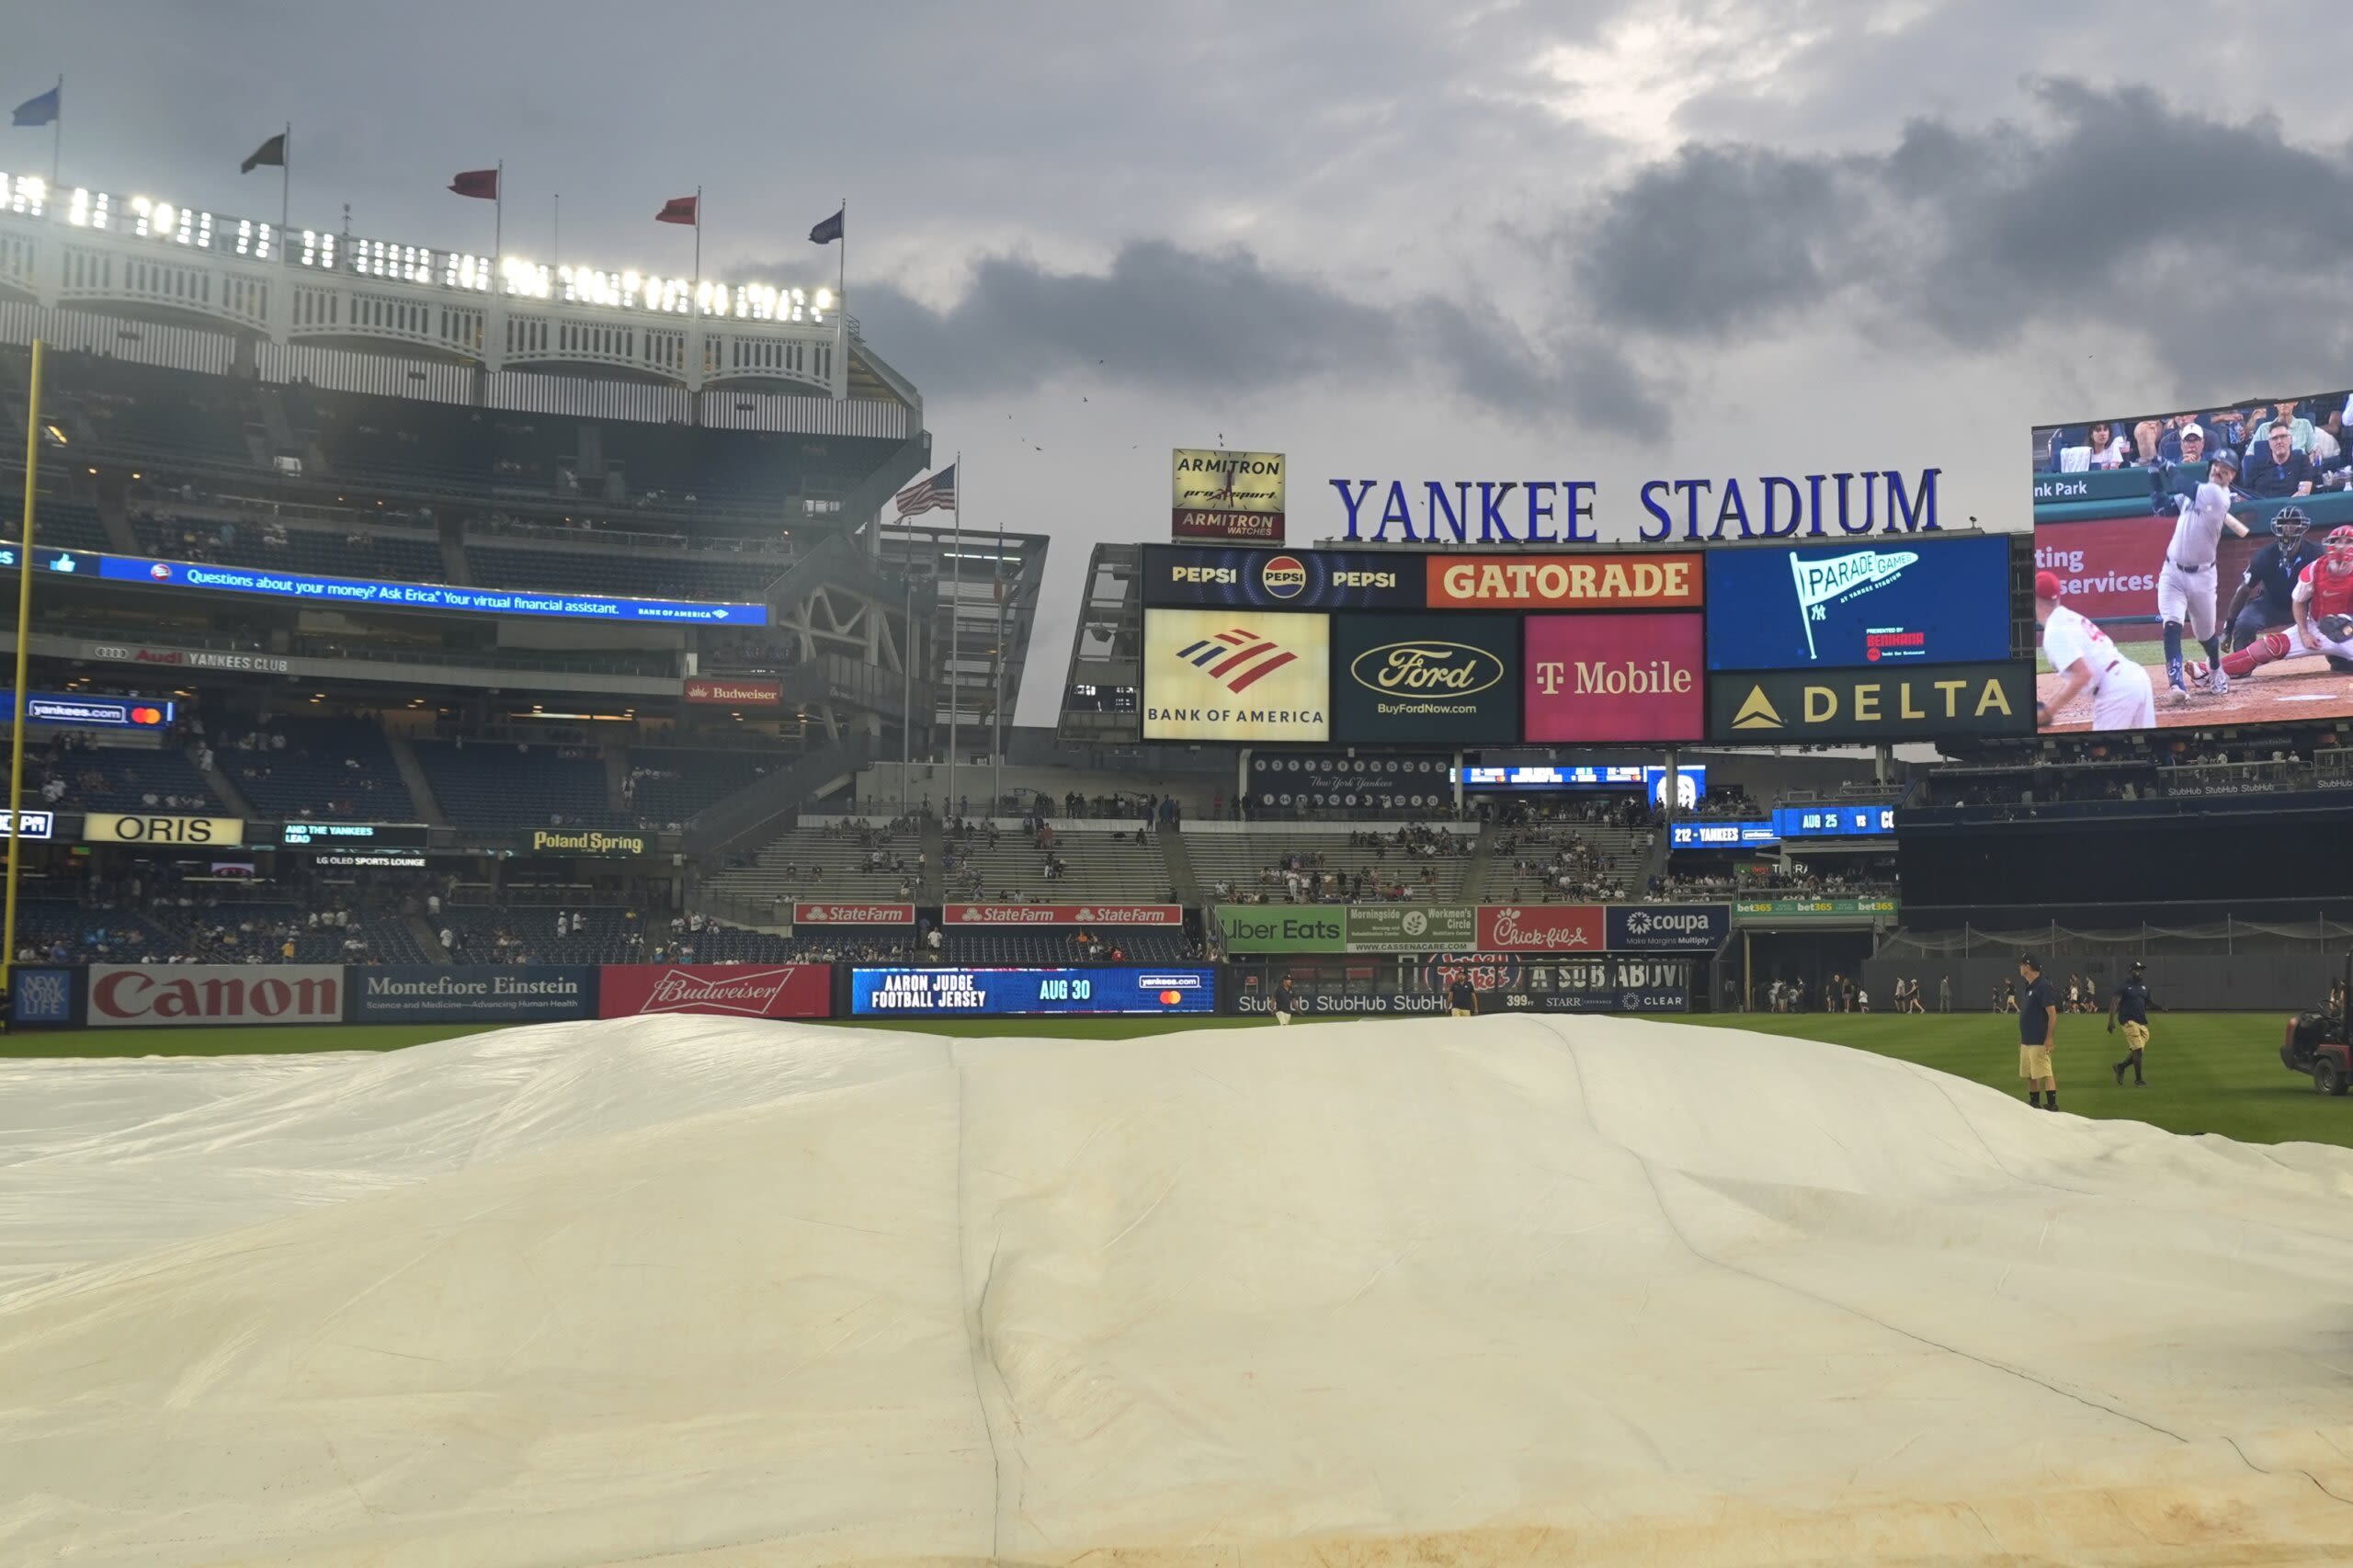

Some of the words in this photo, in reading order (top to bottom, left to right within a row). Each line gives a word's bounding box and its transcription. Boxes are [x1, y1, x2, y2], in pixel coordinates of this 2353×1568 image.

[1177, 459, 1279, 475] ARMITRON
[2055, 481, 2087, 496] Park
[1328, 479, 1597, 543] YANKEE
[1638, 468, 1943, 542] STADIUM
[1182, 513, 1274, 528] ARMITRON
[1227, 527, 1272, 535] WATCHES
[1172, 566, 1237, 585] PEPSI
[1265, 571, 1303, 583] PEPSI
[1332, 572, 1396, 588] PEPSI
[1444, 562, 1689, 599] GATORADE
[1809, 555, 1873, 597] PARADE
[1878, 554, 1913, 574] GAMES
[188, 569, 254, 587] Questions
[256, 576, 293, 592] about
[295, 582, 324, 595] your
[327, 584, 378, 599] money?
[380, 586, 403, 600] Ask
[444, 591, 472, 606] Your
[473, 595, 511, 608] virtual
[514, 597, 563, 611] financial
[564, 601, 620, 616] assistant.
[638, 608, 662, 617] BANK
[662, 608, 674, 618] OF
[674, 609, 711, 619] AMERICA
[135, 649, 183, 664] Audi
[189, 653, 250, 670] YANKEES
[254, 658, 288, 672] CLUB
[1378, 648, 1476, 689] Ford
[1536, 662, 1564, 695] T
[1574, 660, 1692, 695] Mobile
[713, 687, 778, 699] Budweiser
[1803, 678, 2013, 723] DELTA
[33, 702, 122, 720] yankees.com
[1148, 709, 1201, 722] BANK
[1206, 709, 1232, 722] OF
[1236, 710, 1324, 724] AMERICA
[1378, 703, 1477, 715] BuyFordNow.com
[1331, 776, 1355, 791] York
[1355, 777, 1393, 791] Yankees
[2204, 787, 2238, 795] StubHub
[2241, 783, 2275, 792] StubHub
[2316, 779, 2353, 790] StubHub
[2167, 788, 2202, 797] StubHub
[1802, 814, 1822, 829] AUG
[1824, 813, 1838, 828] 25
[115, 816, 212, 843] ORIS
[285, 824, 308, 835] AND
[308, 825, 328, 835] THE
[329, 826, 374, 836] YANKEES
[1675, 828, 1692, 843] 212
[1699, 827, 1739, 842] YANKEES
[285, 834, 311, 844] LEAD
[533, 831, 588, 850] Poland
[589, 832, 643, 855] Spring
[316, 856, 329, 865] LG
[329, 857, 354, 865] OLED
[355, 857, 391, 866] SPORTS
[390, 858, 426, 867] LOUNGE
[1428, 908, 1472, 919] Workmen's
[1737, 903, 1772, 912] bet365
[1797, 903, 1833, 911] bet365
[1858, 902, 1894, 911] bet365
[1350, 908, 1401, 922] Morningside
[1283, 919, 1340, 939] Eats
[1447, 919, 1472, 930] Circle
[1494, 912, 1588, 948] Chick-fil-A
[1653, 915, 1710, 935] coupa
[1356, 943, 1468, 951] WWW.CASSENACARE.COM
[1626, 937, 1644, 945] Make
[1645, 937, 1677, 947] Margins
[25, 976, 63, 989] NEW
[368, 976, 488, 995] Montefiore
[493, 976, 578, 994] Einstein
[654, 978, 779, 1002] Budweiser
[884, 974, 928, 992] AARON
[932, 974, 974, 992] JUDGE
[20, 988, 64, 1002] YORK
[93, 971, 337, 1018] Canon
[1040, 981, 1068, 1001] AUG
[1072, 980, 1091, 1000] 30
[367, 1000, 403, 1010] Science
[403, 1000, 420, 1009] and
[518, 999, 550, 1008] Human
[551, 998, 578, 1008] Health
[871, 991, 934, 1008] FOOTBALL
[938, 991, 986, 1008] JERSEY
[1316, 995, 1386, 1012] StubHub
[1546, 997, 1582, 1007] STARR
[1643, 997, 1683, 1006] CLEAR
[24, 1001, 61, 1015] LIFE
